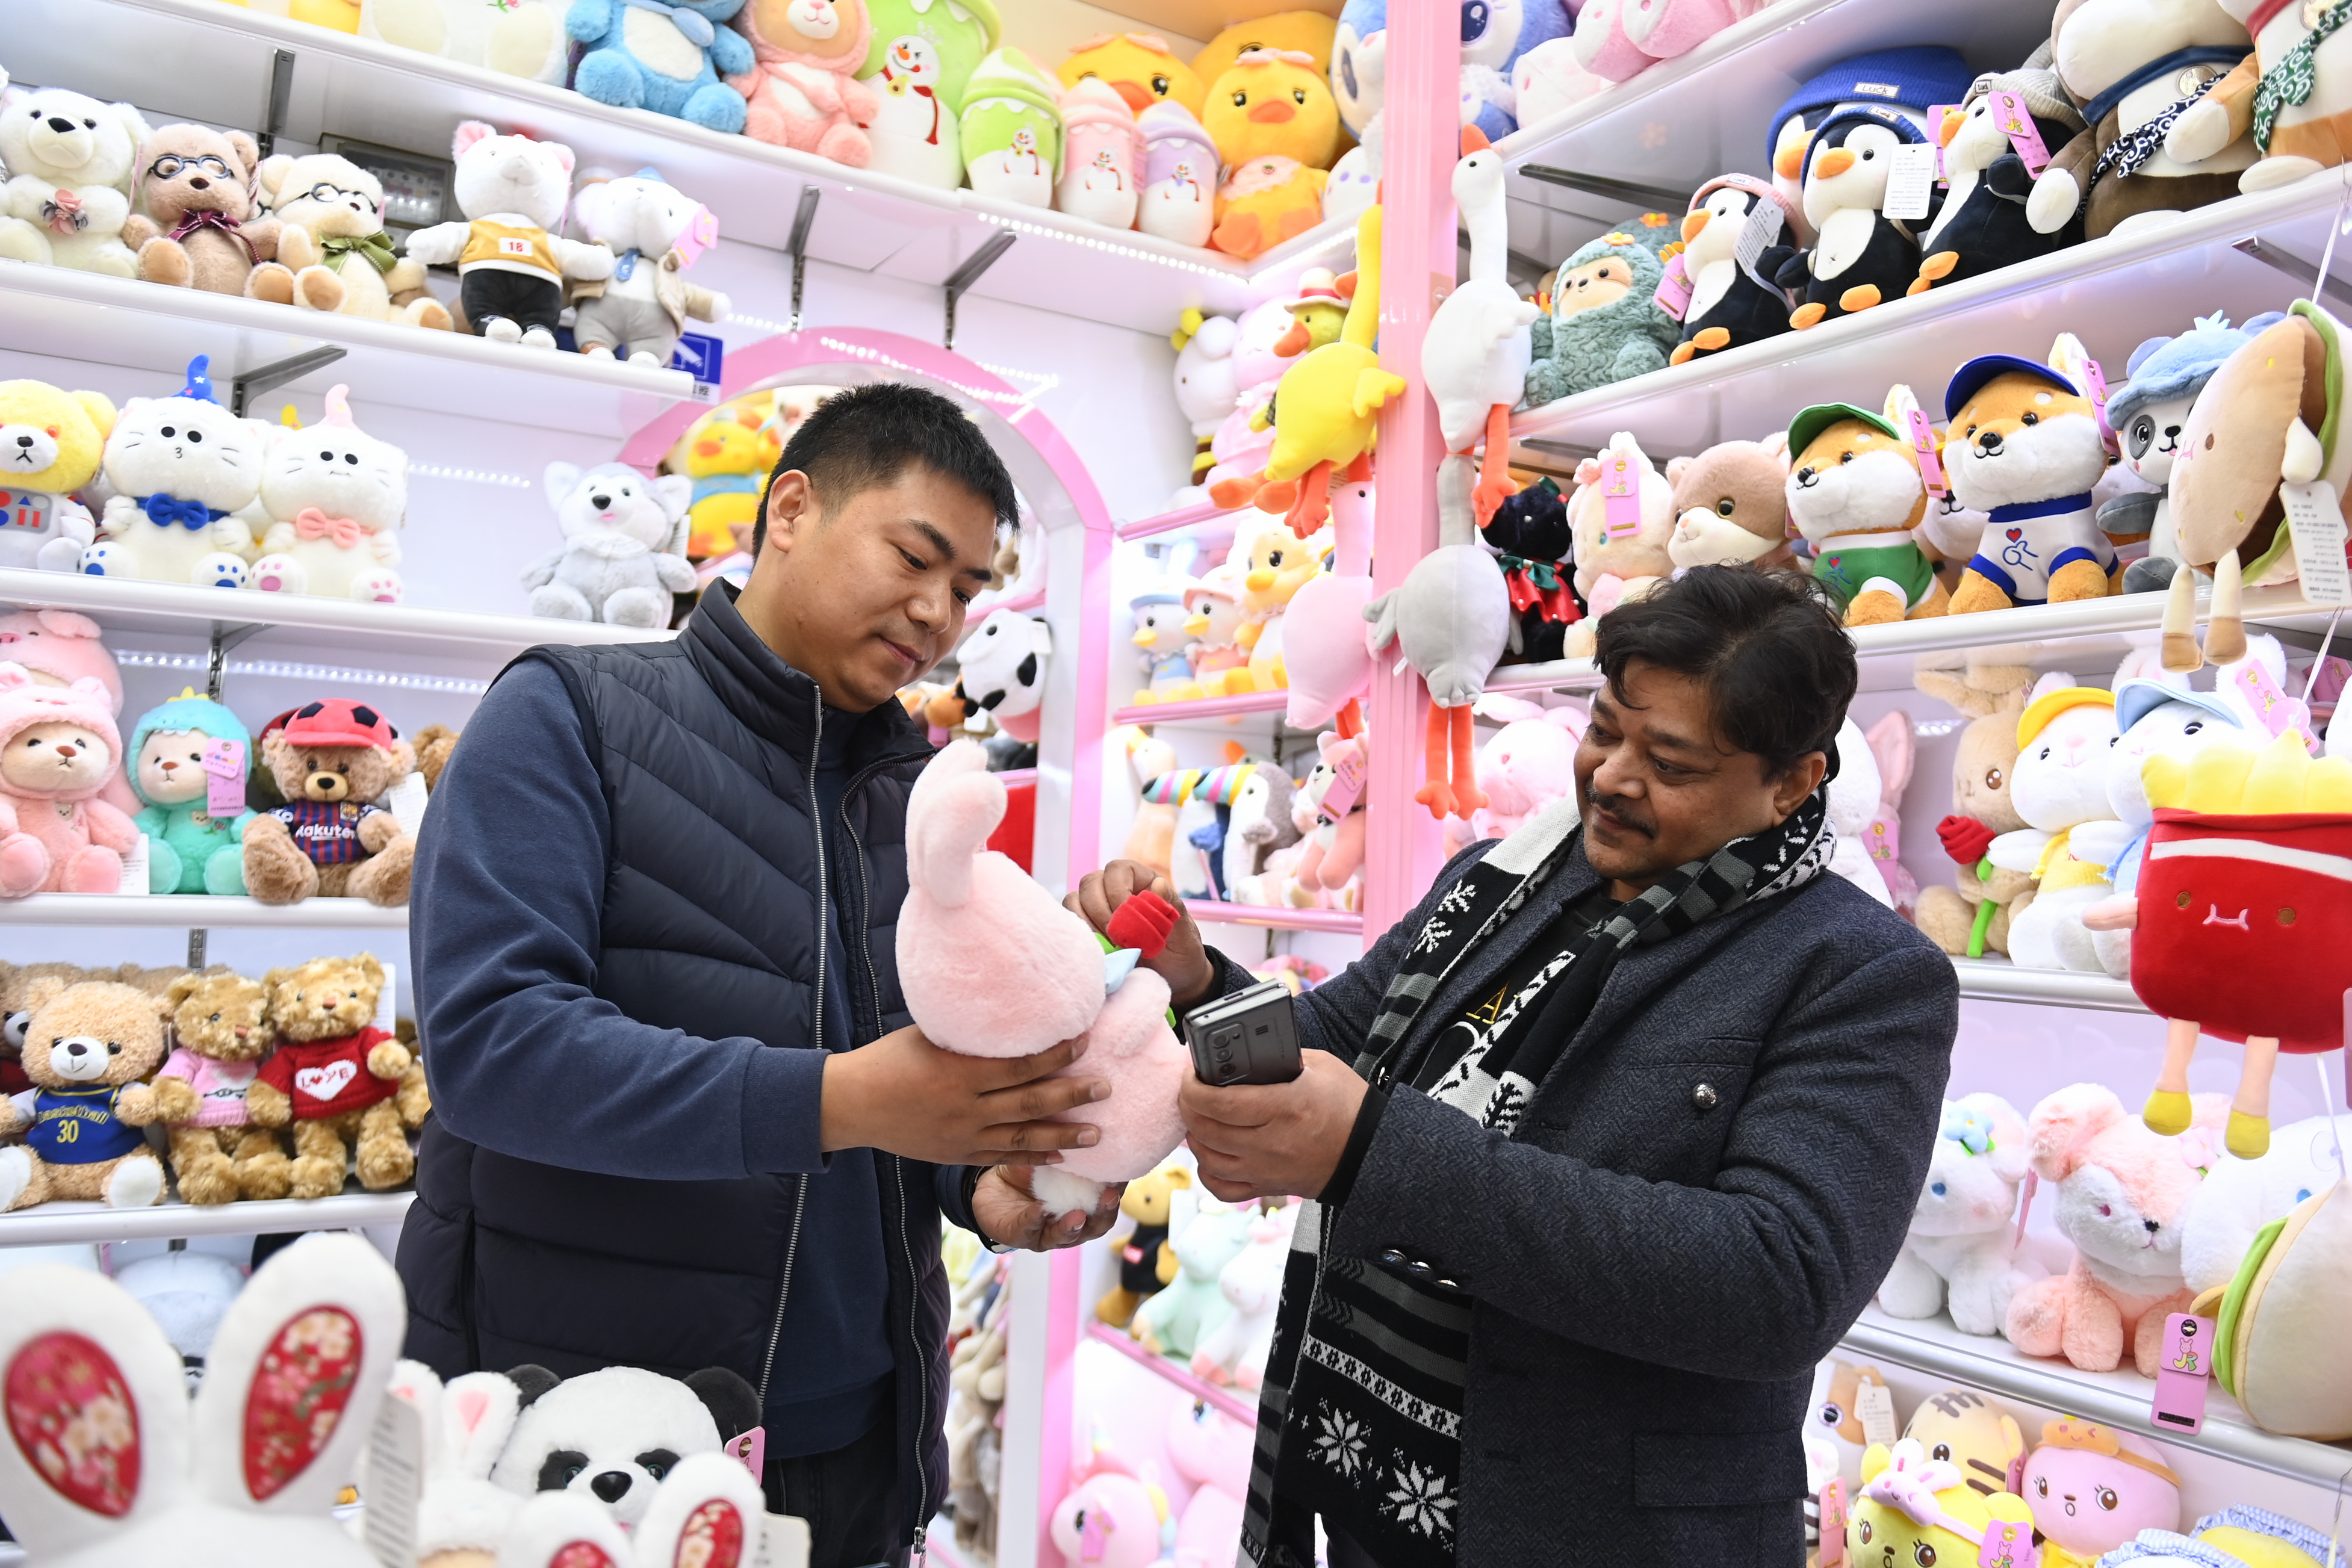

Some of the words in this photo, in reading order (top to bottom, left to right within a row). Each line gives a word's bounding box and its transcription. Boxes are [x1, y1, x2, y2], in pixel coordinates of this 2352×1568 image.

[1861, 84, 1888, 95] Luck
[509, 241, 523, 252] 18
[57, 1120, 79, 1143] 30
